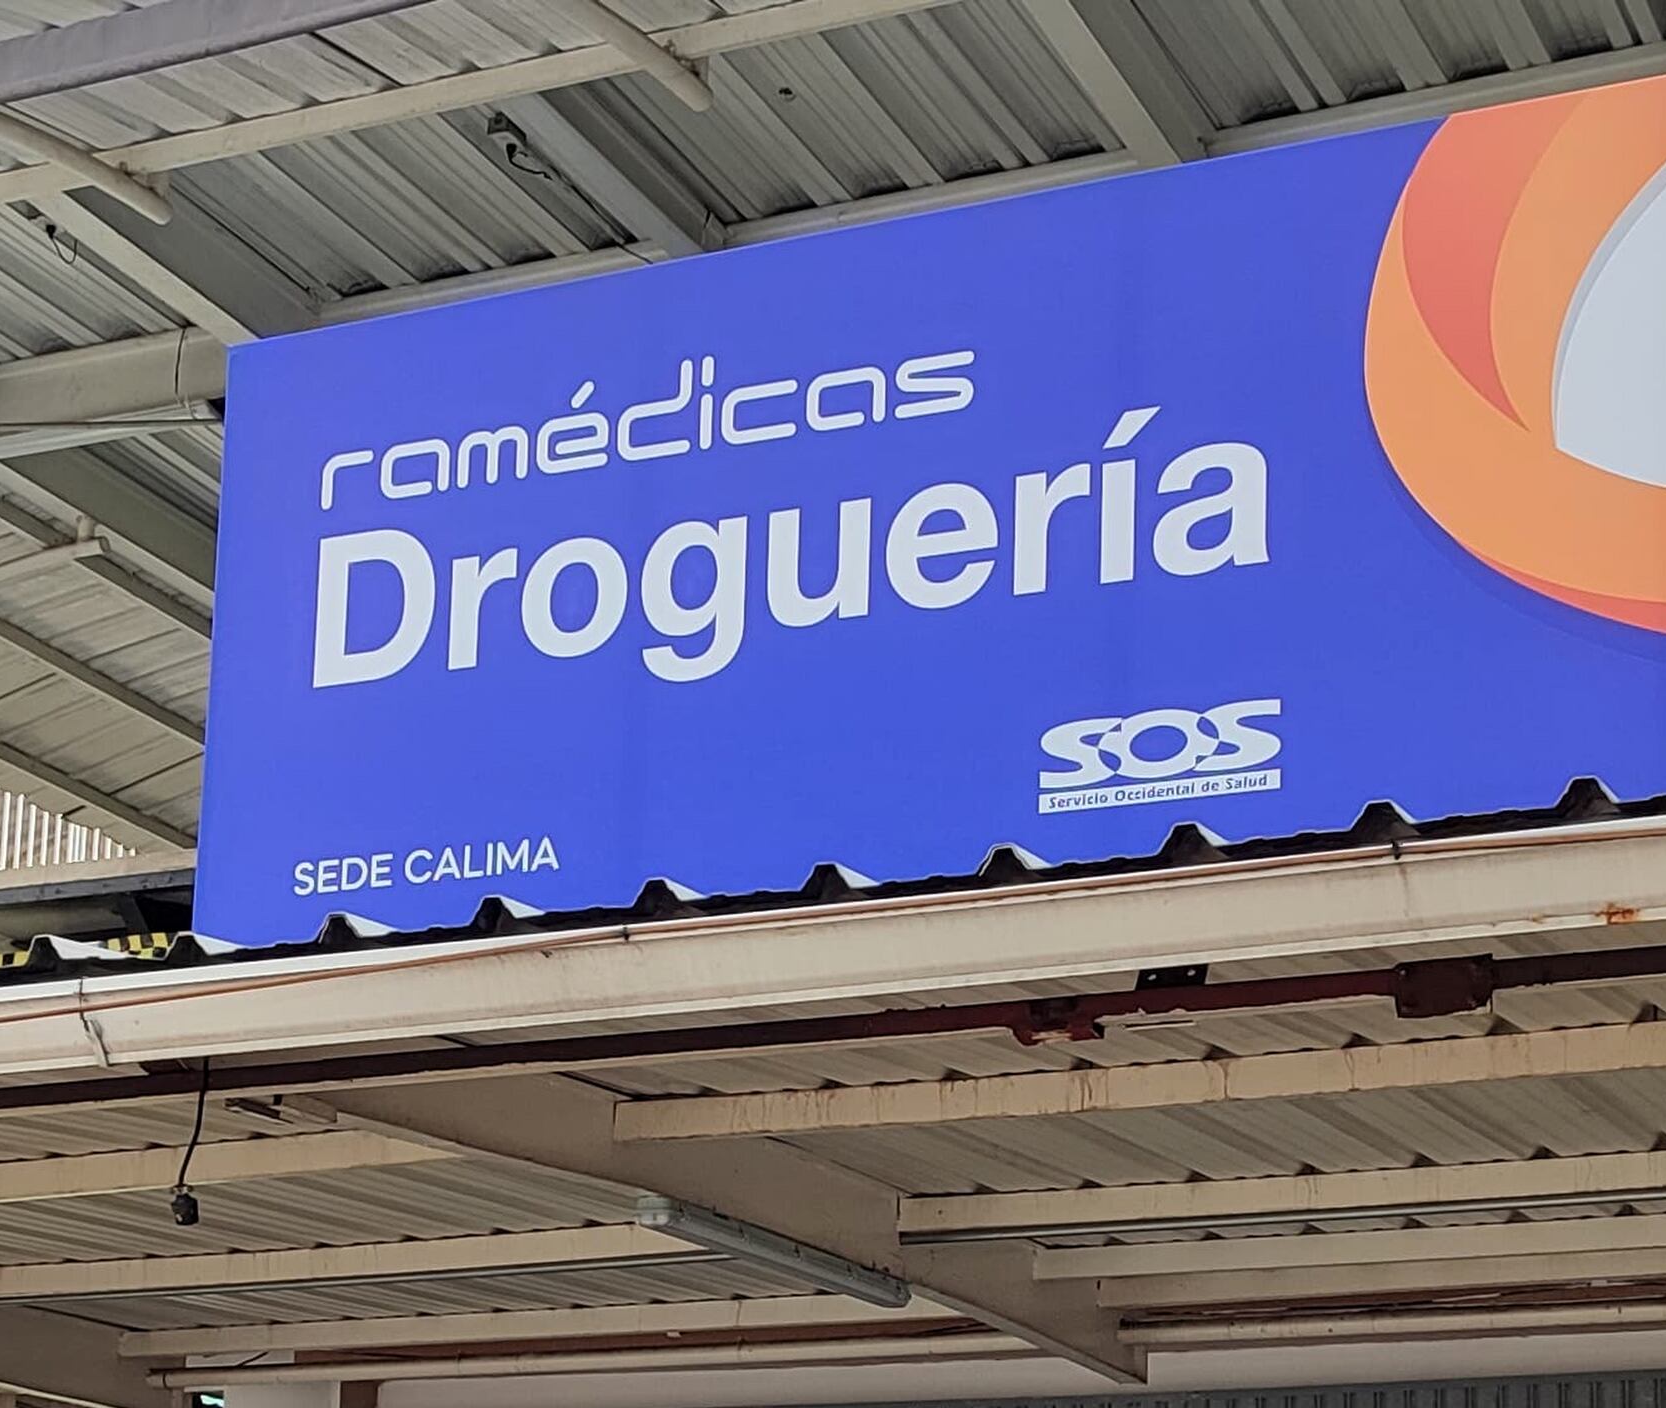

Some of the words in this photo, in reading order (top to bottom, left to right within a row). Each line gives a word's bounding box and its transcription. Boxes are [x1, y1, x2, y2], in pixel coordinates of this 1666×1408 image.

[320, 350, 975, 511] ramédicas
[312, 406, 1269, 688] Droguería
[1039, 698, 1281, 789] SOS
[1048, 793, 1108, 809] Servicio
[1114, 782, 1195, 802] Occidental
[1201, 781, 1220, 793] de
[1225, 774, 1268, 790] Salud
[293, 853, 394, 896] SEDE
[404, 836, 560, 884] CALIMA
